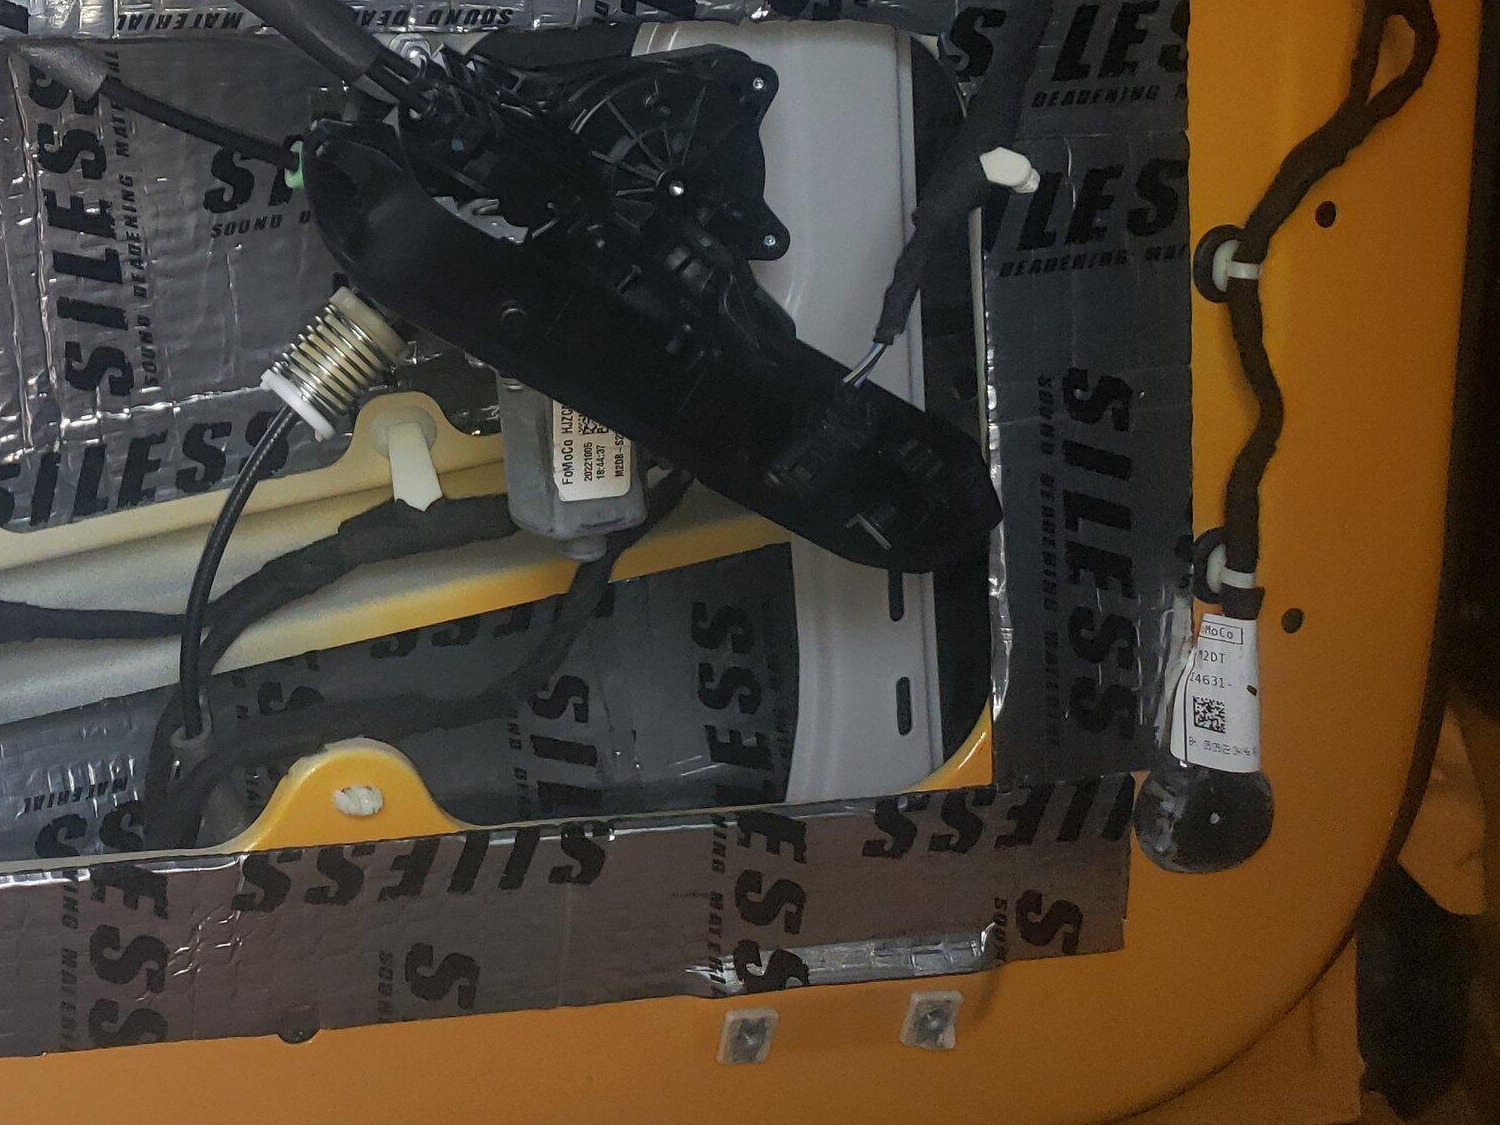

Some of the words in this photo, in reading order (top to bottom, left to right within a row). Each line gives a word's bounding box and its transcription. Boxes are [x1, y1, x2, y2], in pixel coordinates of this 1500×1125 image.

[117, 9, 245, 31] MATERIAL
[426, 7, 514, 27] SOUND
[105, 49, 136, 159] MATEIAL
[1031, 84, 1160, 109] DEADENING
[119, 173, 150, 301] DEADENING
[210, 213, 283, 240] SOUND
[1000, 246, 1130, 278] DEADENING
[138, 314, 162, 387] SOUND
[1037, 374, 1055, 455] SOUND
[562, 439, 574, 485] FoMoCo
[583, 441, 593, 482] 20221005
[596, 444, 606, 480] 18:44:37
[1040, 472, 1060, 612] DEADENING
[1062, 368, 1143, 739] SILESS
[1202, 627, 1234, 640] MoCo
[23, 777, 128, 813] MATERIAL
[232, 819, 606, 914] SILESS
